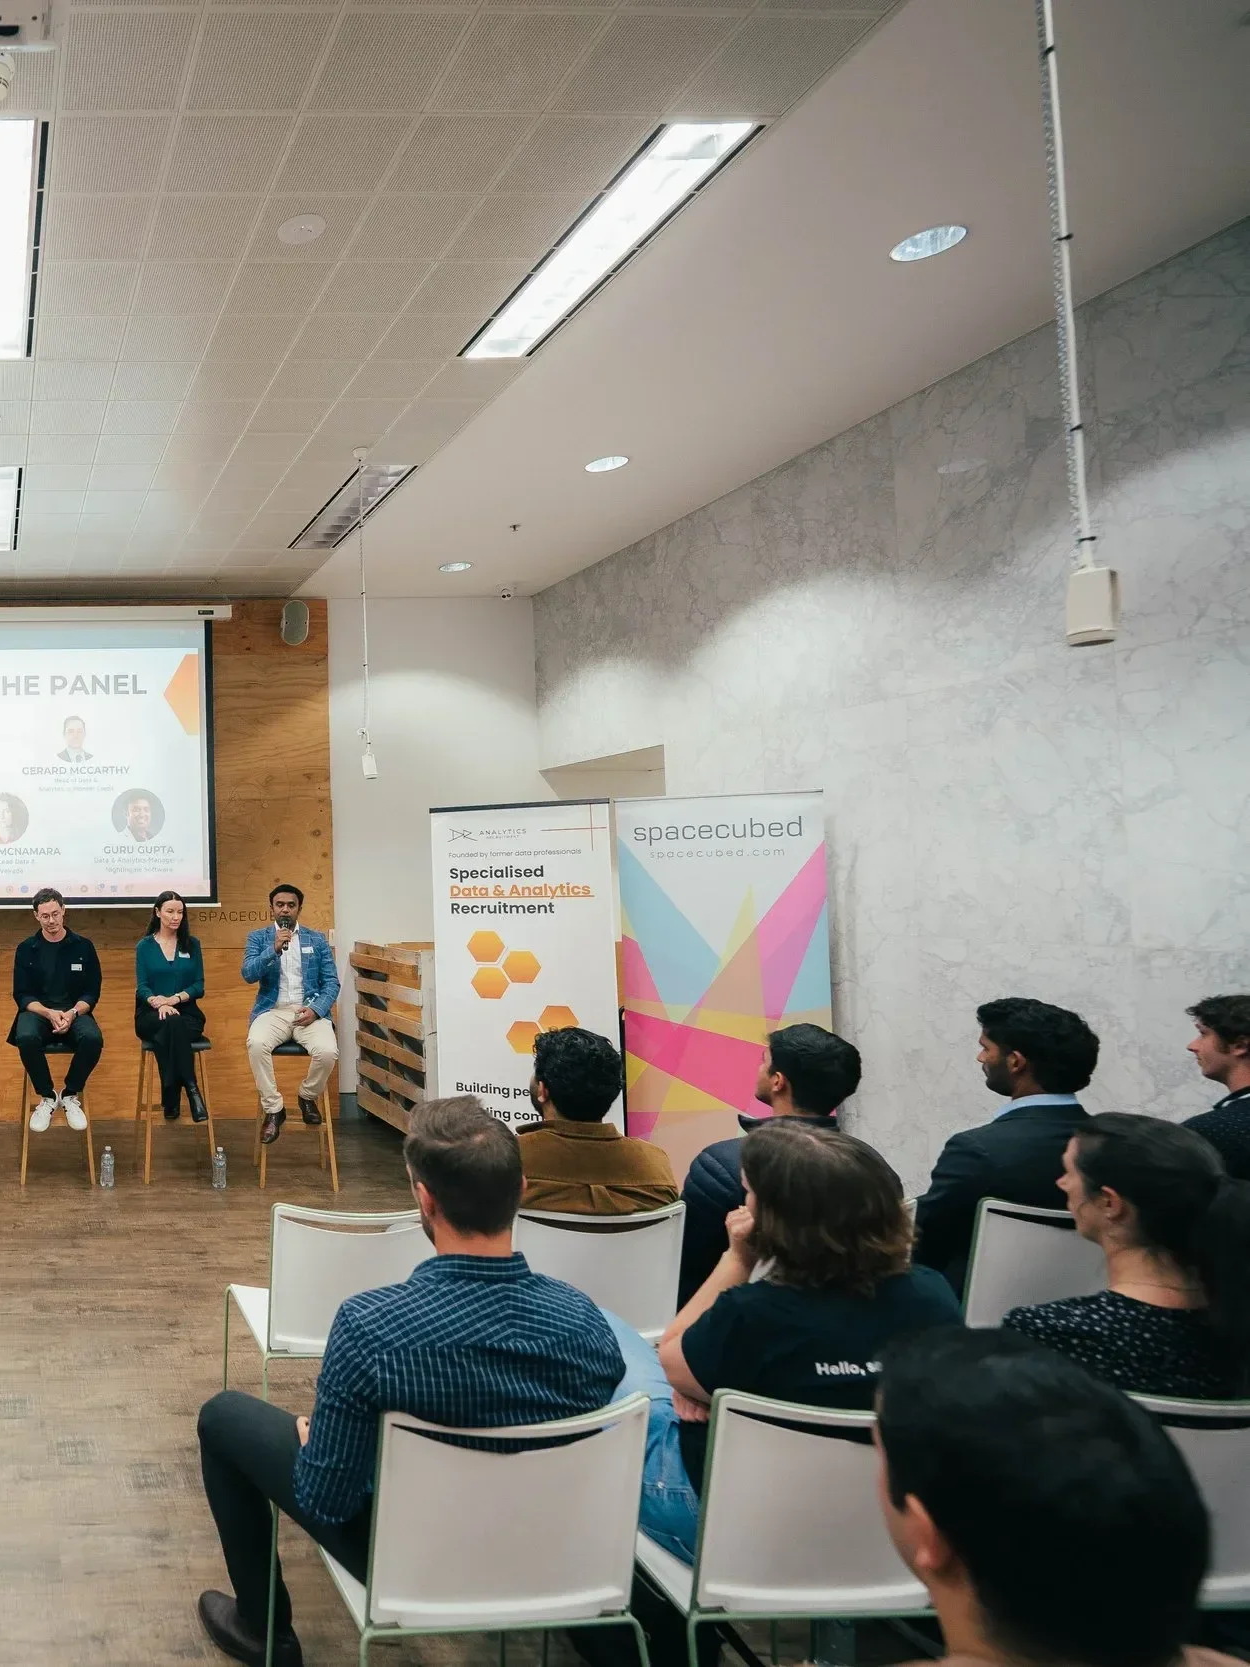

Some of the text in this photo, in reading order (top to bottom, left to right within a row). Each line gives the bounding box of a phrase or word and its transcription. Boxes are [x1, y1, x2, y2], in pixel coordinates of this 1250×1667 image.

[50, 674, 147, 695] PANEL
[22, 765, 130, 776] GERARD MCCARTHY
[479, 828, 527, 836] ANALYTICS
[634, 815, 803, 846] spacecubed
[103, 845, 175, 854] GURU GUPTA
[448, 848, 582, 859] Founded by former data professionals
[649, 848, 785, 860] spacecubed.com
[450, 865, 544, 883] Specialised
[450, 882, 591, 899] Data & Analytics
[451, 901, 555, 915] Recruitment
[456, 1082, 530, 1099] Building pe
[486, 1107, 545, 1122] ing com
[815, 1361, 866, 1376] Hello,
